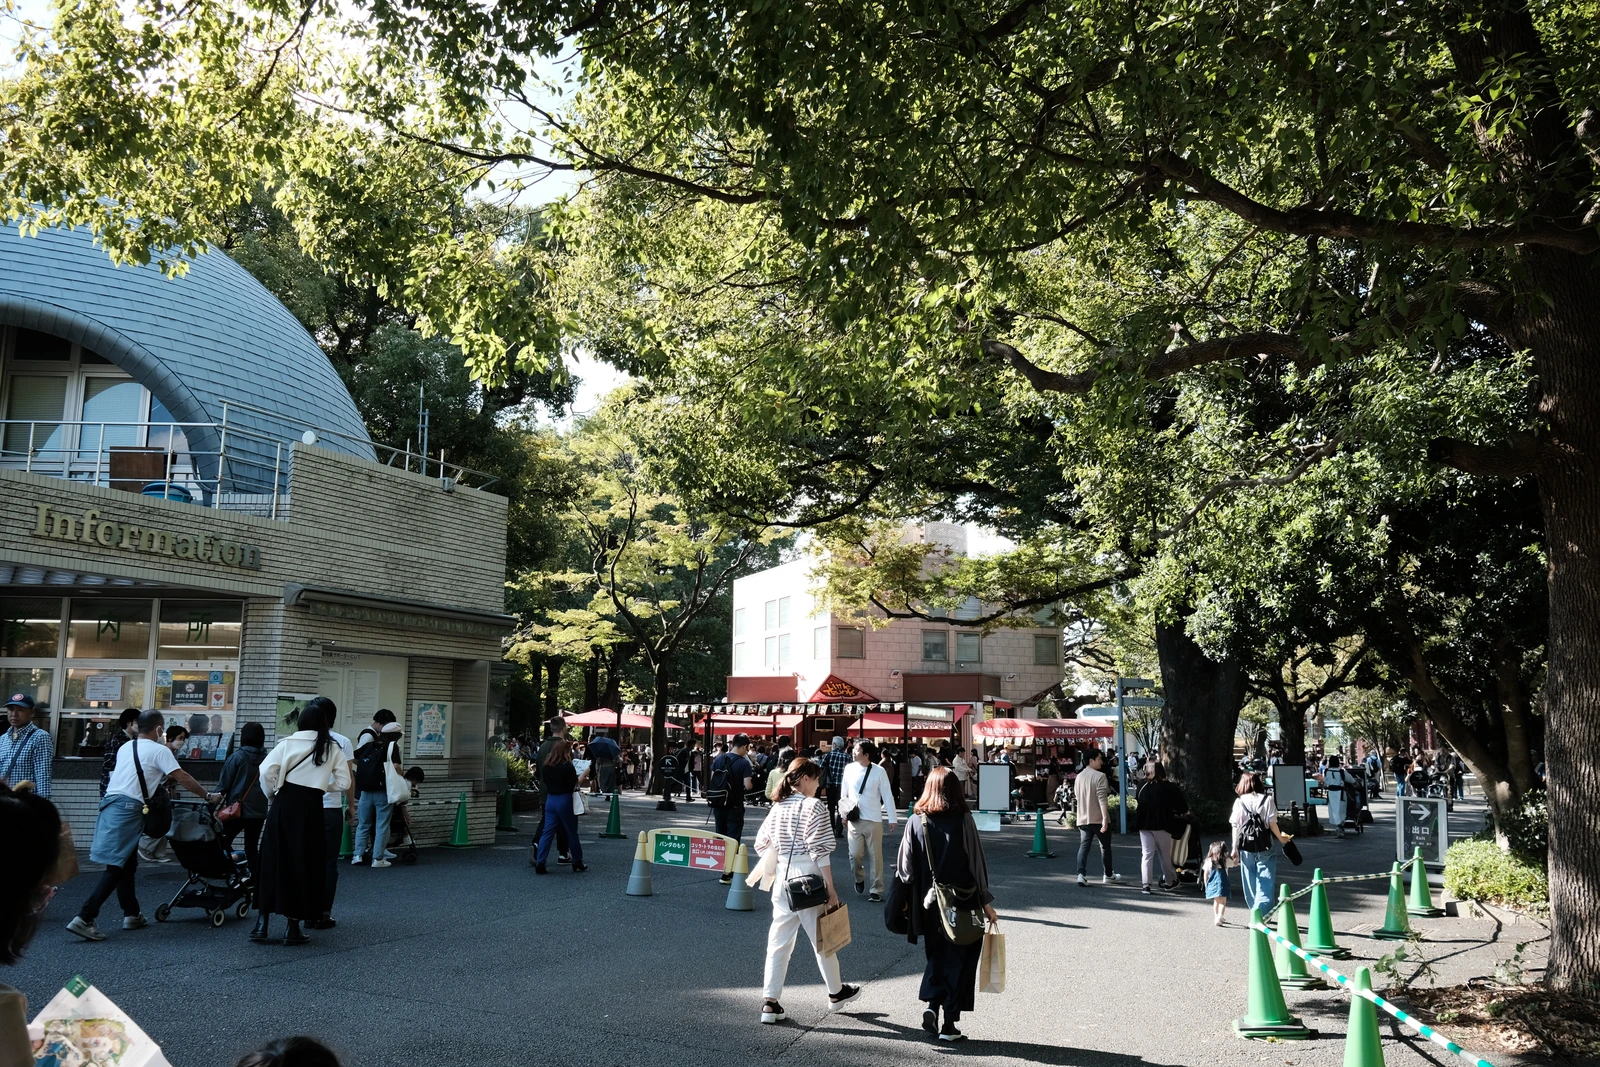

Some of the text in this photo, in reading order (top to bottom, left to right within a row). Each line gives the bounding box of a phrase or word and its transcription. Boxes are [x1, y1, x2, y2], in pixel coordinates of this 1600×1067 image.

[32, 502, 261, 570] Information
[1004, 727, 1018, 735] SHOP
[1412, 825, 1430, 835] 出口
[659, 841, 686, 849] パンダのもり
